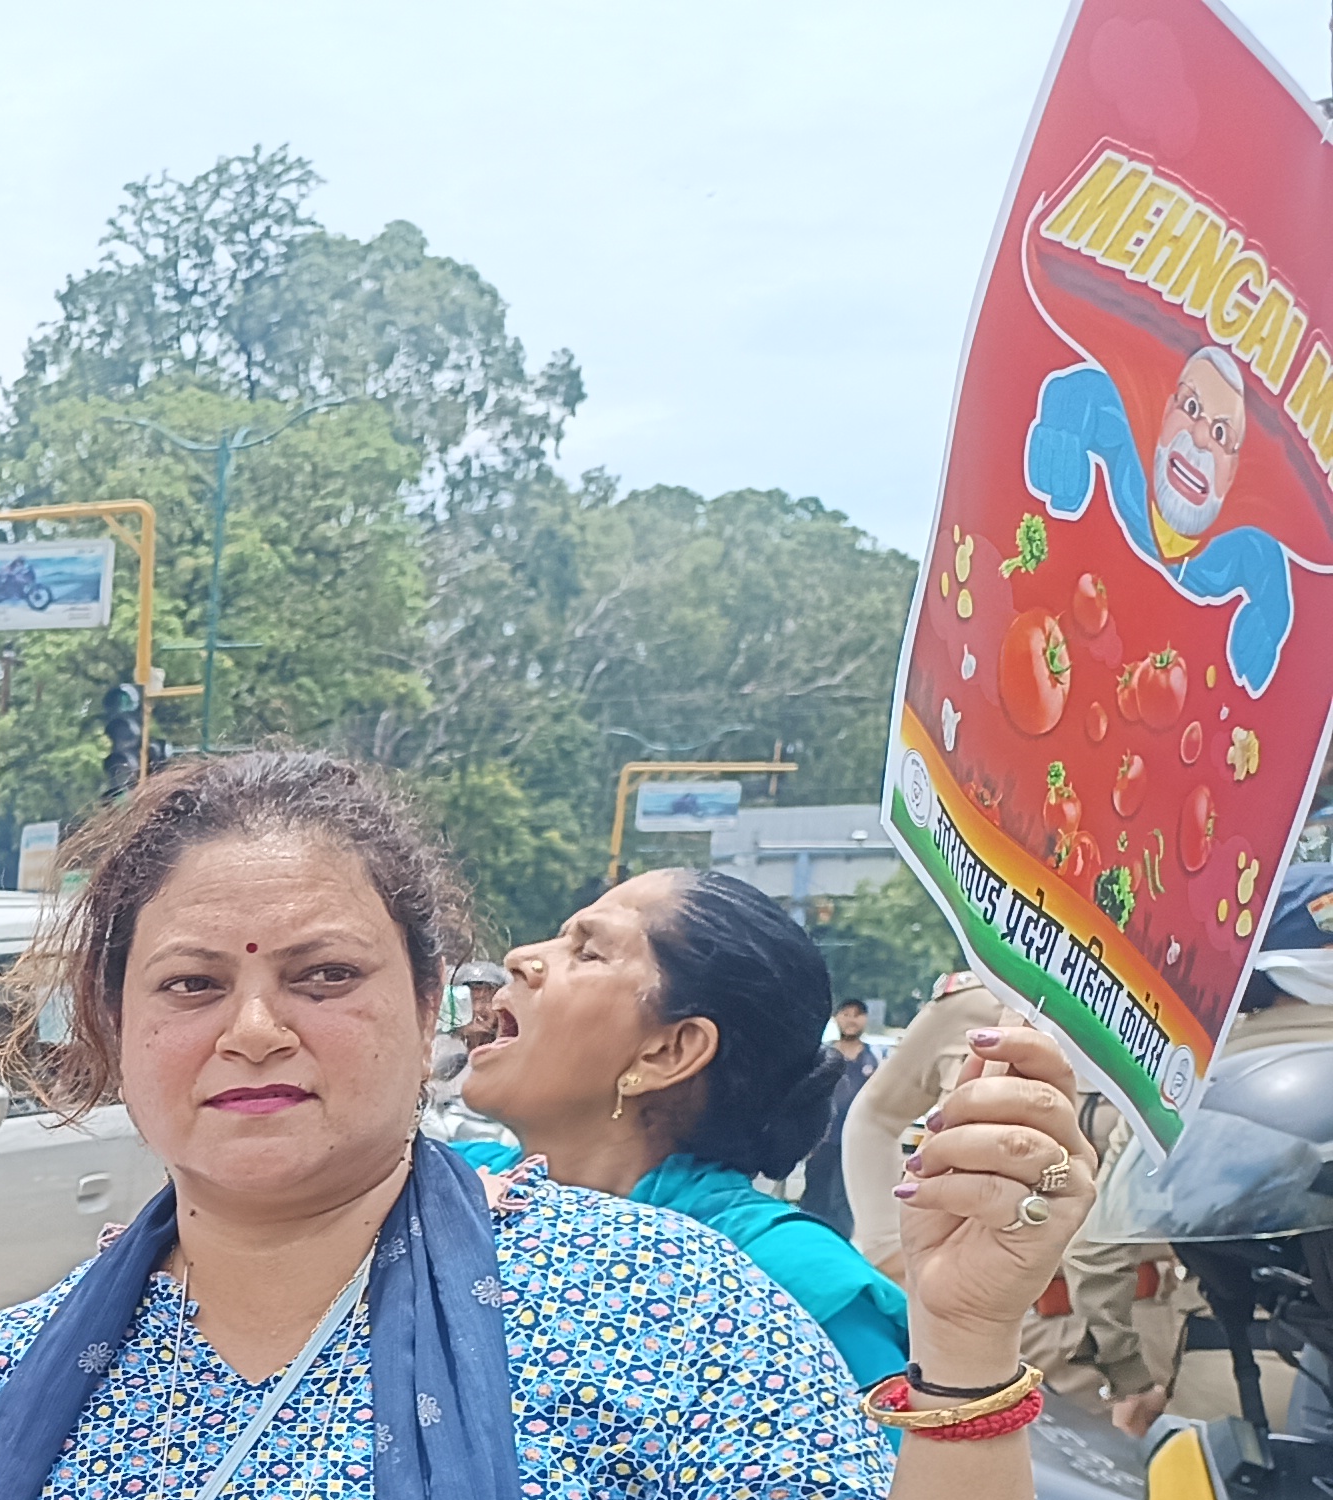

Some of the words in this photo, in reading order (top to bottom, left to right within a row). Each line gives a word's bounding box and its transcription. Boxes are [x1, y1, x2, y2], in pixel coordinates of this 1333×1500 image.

[1040, 149, 1309, 395] MEHNGAI
[933, 794, 1007, 925] उत्तराखण्ड
[1000, 887, 1064, 973] प्रदेश
[1060, 935, 1124, 1029] महिला
[1119, 991, 1170, 1081] कांग्रेस
